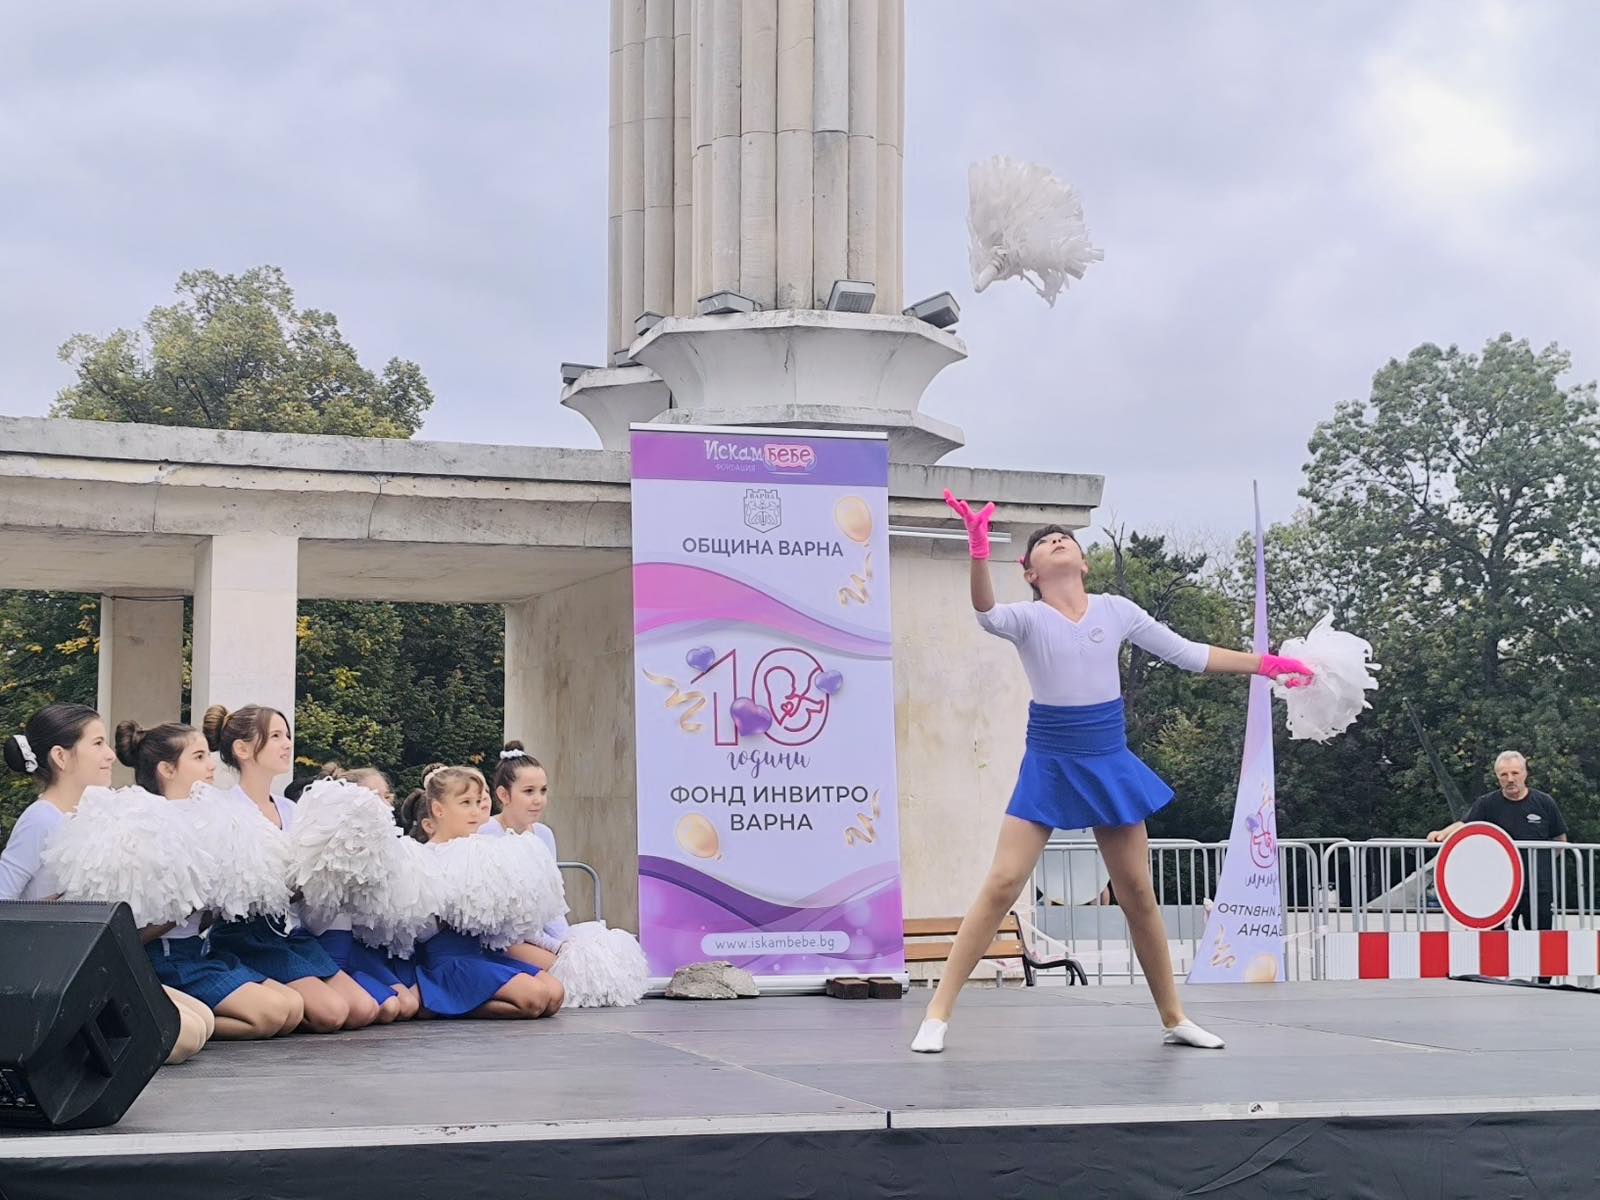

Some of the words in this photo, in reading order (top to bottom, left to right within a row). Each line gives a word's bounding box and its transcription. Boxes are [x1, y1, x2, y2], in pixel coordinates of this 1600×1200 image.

[682, 537, 773, 558] ОБЩИНА
[779, 540, 844, 557] ВАРНА
[690, 648, 830, 746] 10
[727, 749, 811, 778] години
[670, 785, 746, 806] ФОНД
[753, 785, 869, 804] ИНВИТРО
[730, 813, 814, 831] ВАРНА
[714, 934, 835, 950] www.iskambebe.bg
